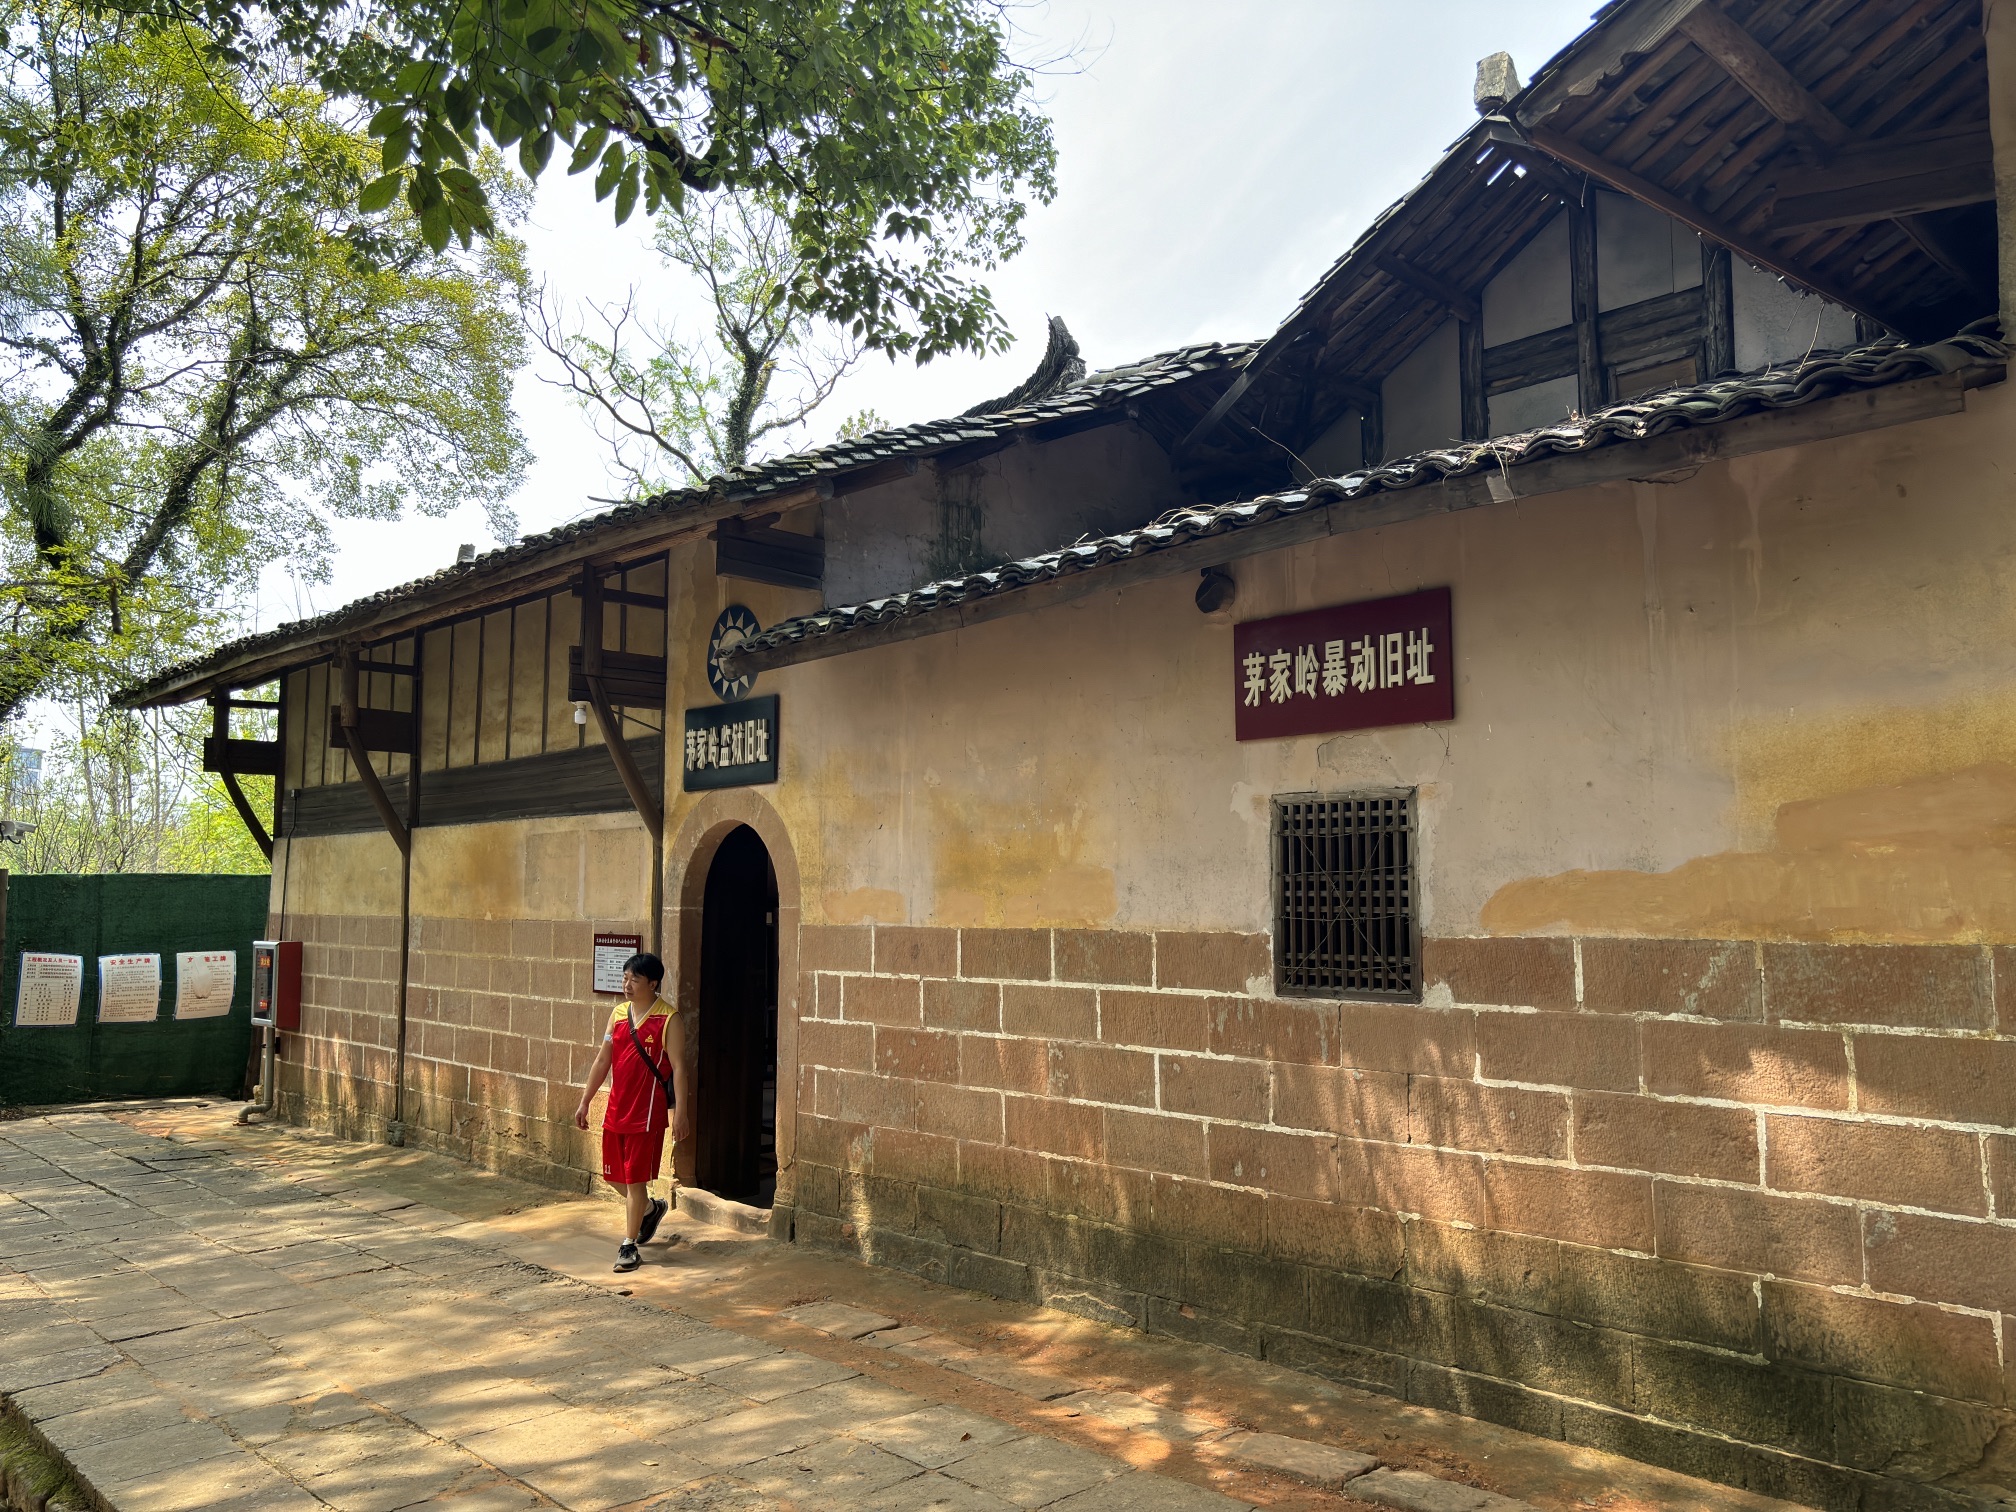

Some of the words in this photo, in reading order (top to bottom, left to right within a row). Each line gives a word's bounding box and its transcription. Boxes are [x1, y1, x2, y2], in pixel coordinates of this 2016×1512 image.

[1242, 627, 1436, 707] 茅家岭暴动旧址
[686, 718, 770, 771] 茅家岭监狱旧址
[109, 957, 151, 966] 安全生产牌
[604, 1164, 612, 1175] 11
